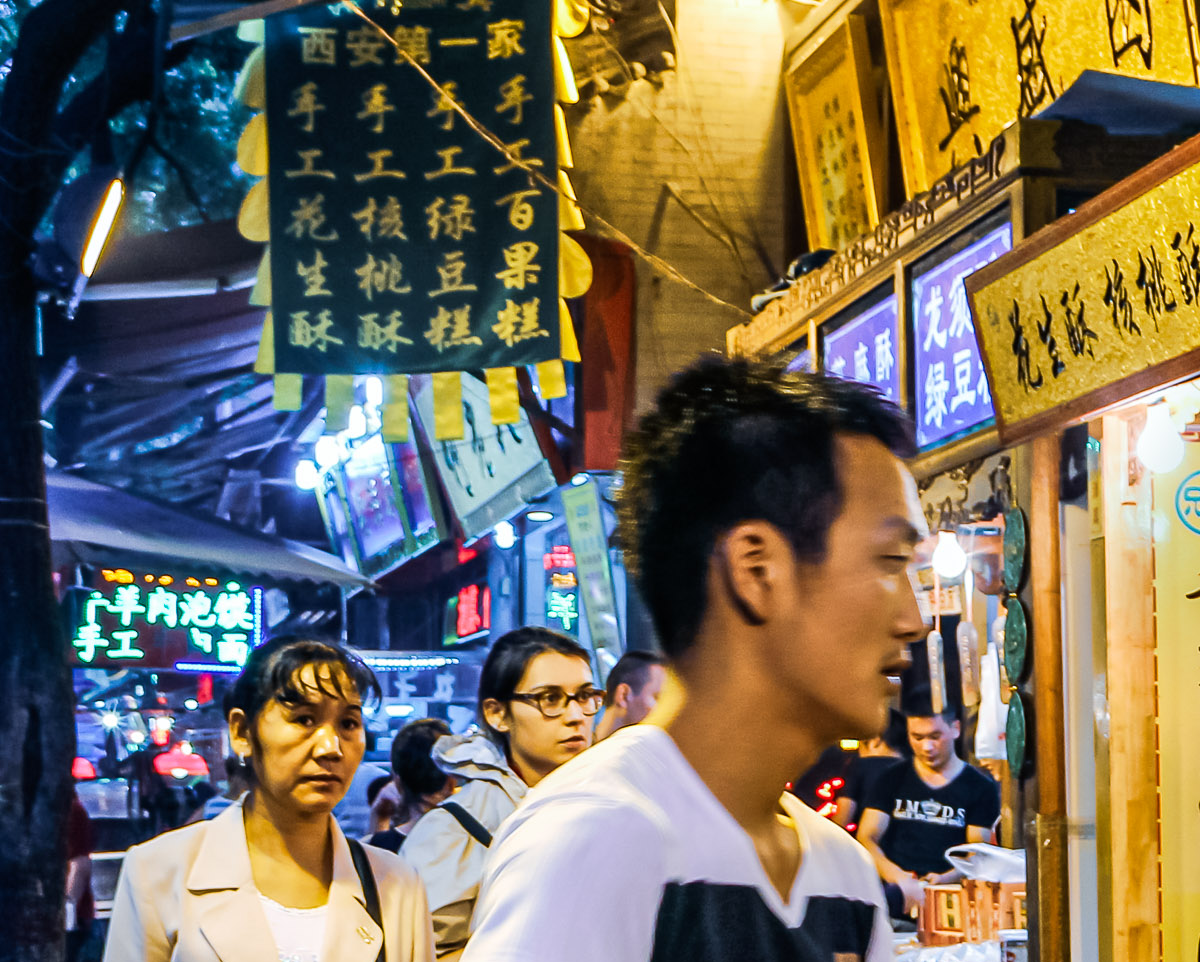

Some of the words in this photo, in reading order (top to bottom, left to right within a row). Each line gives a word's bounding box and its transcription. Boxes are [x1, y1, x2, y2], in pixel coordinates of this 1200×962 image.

[297, 18, 527, 67] 西安第一家
[285, 81, 344, 353] 手工花生酥
[352, 82, 413, 354] 手工核桃酥
[424, 80, 483, 353] 手工绿豆糕
[491, 73, 550, 348] 手工百果糕
[1008, 280, 1098, 393] 花生酥
